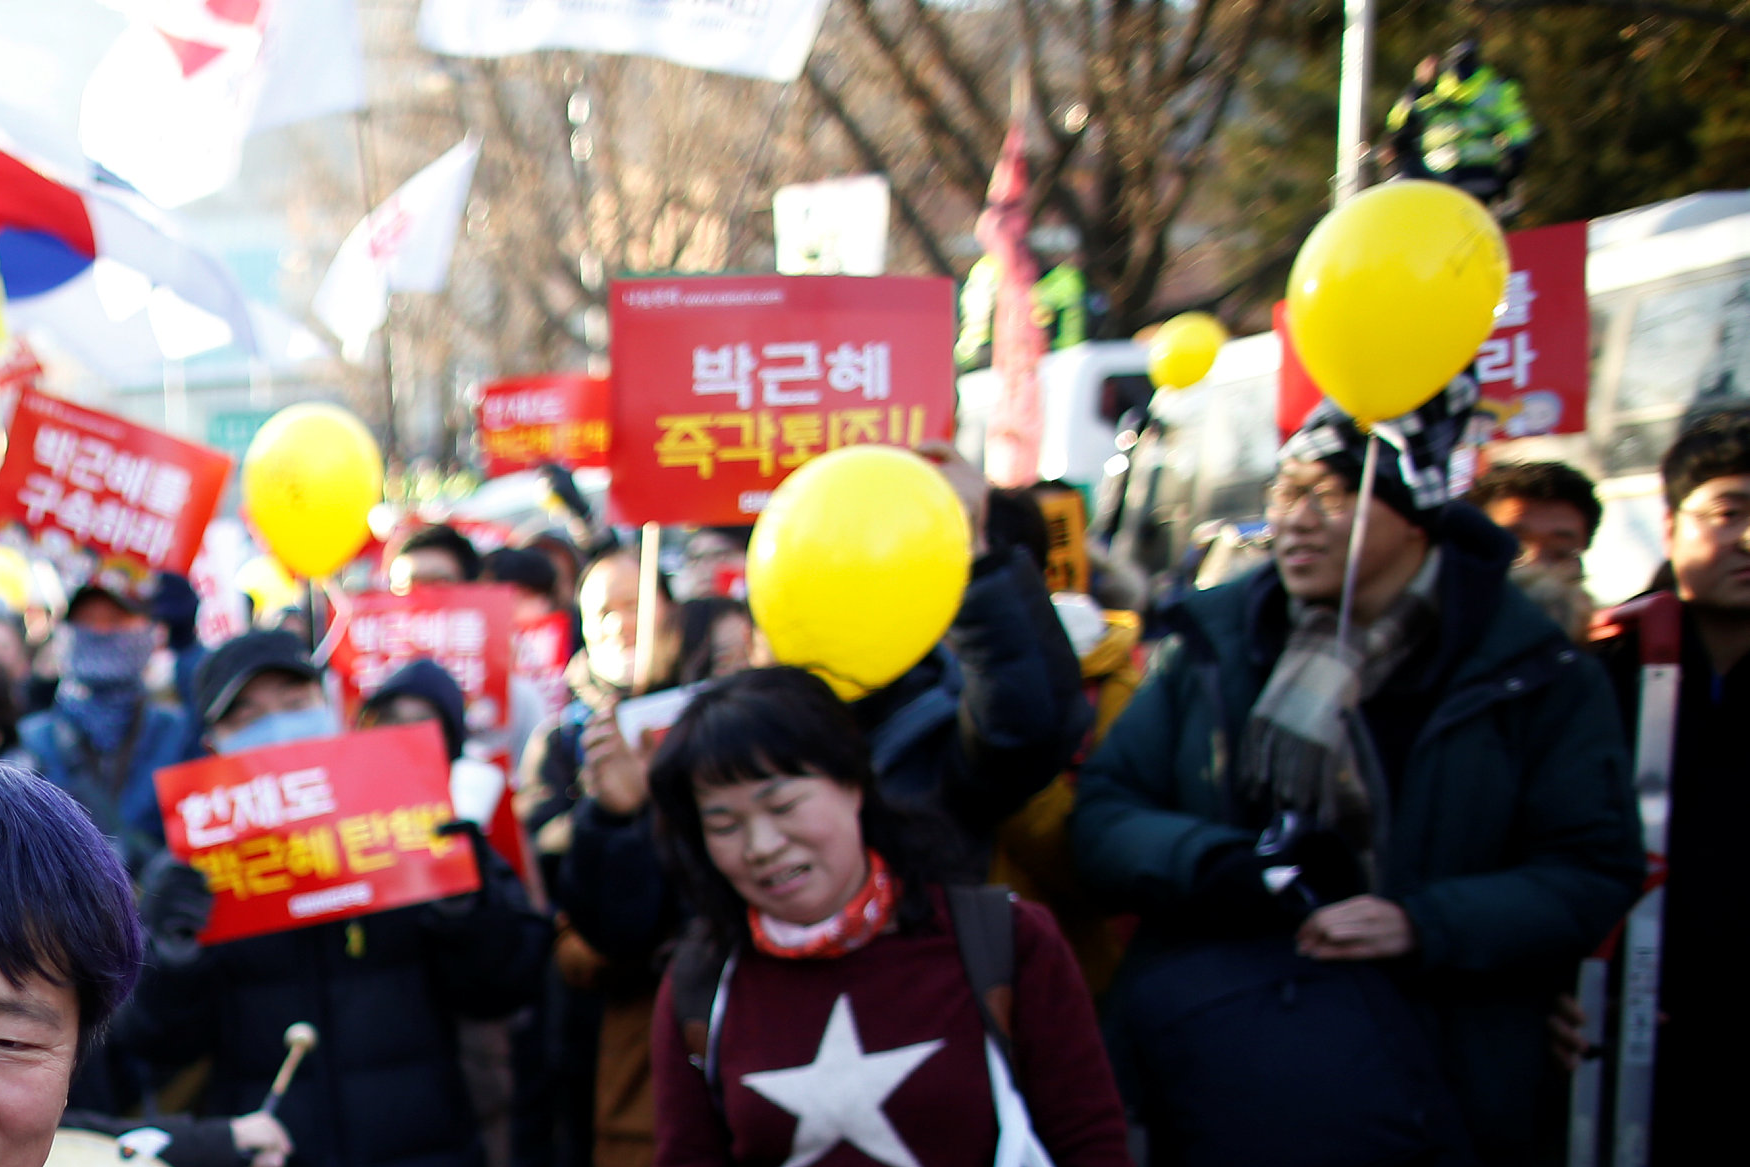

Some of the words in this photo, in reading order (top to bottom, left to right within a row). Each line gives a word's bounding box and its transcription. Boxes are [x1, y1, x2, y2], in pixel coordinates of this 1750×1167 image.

[691, 340, 892, 411] 박근혜
[33, 423, 193, 516] 박근혜를
[16, 472, 176, 567] 구속하라
[175, 766, 338, 849] 헌재도
[188, 824, 341, 900] 박근혜
